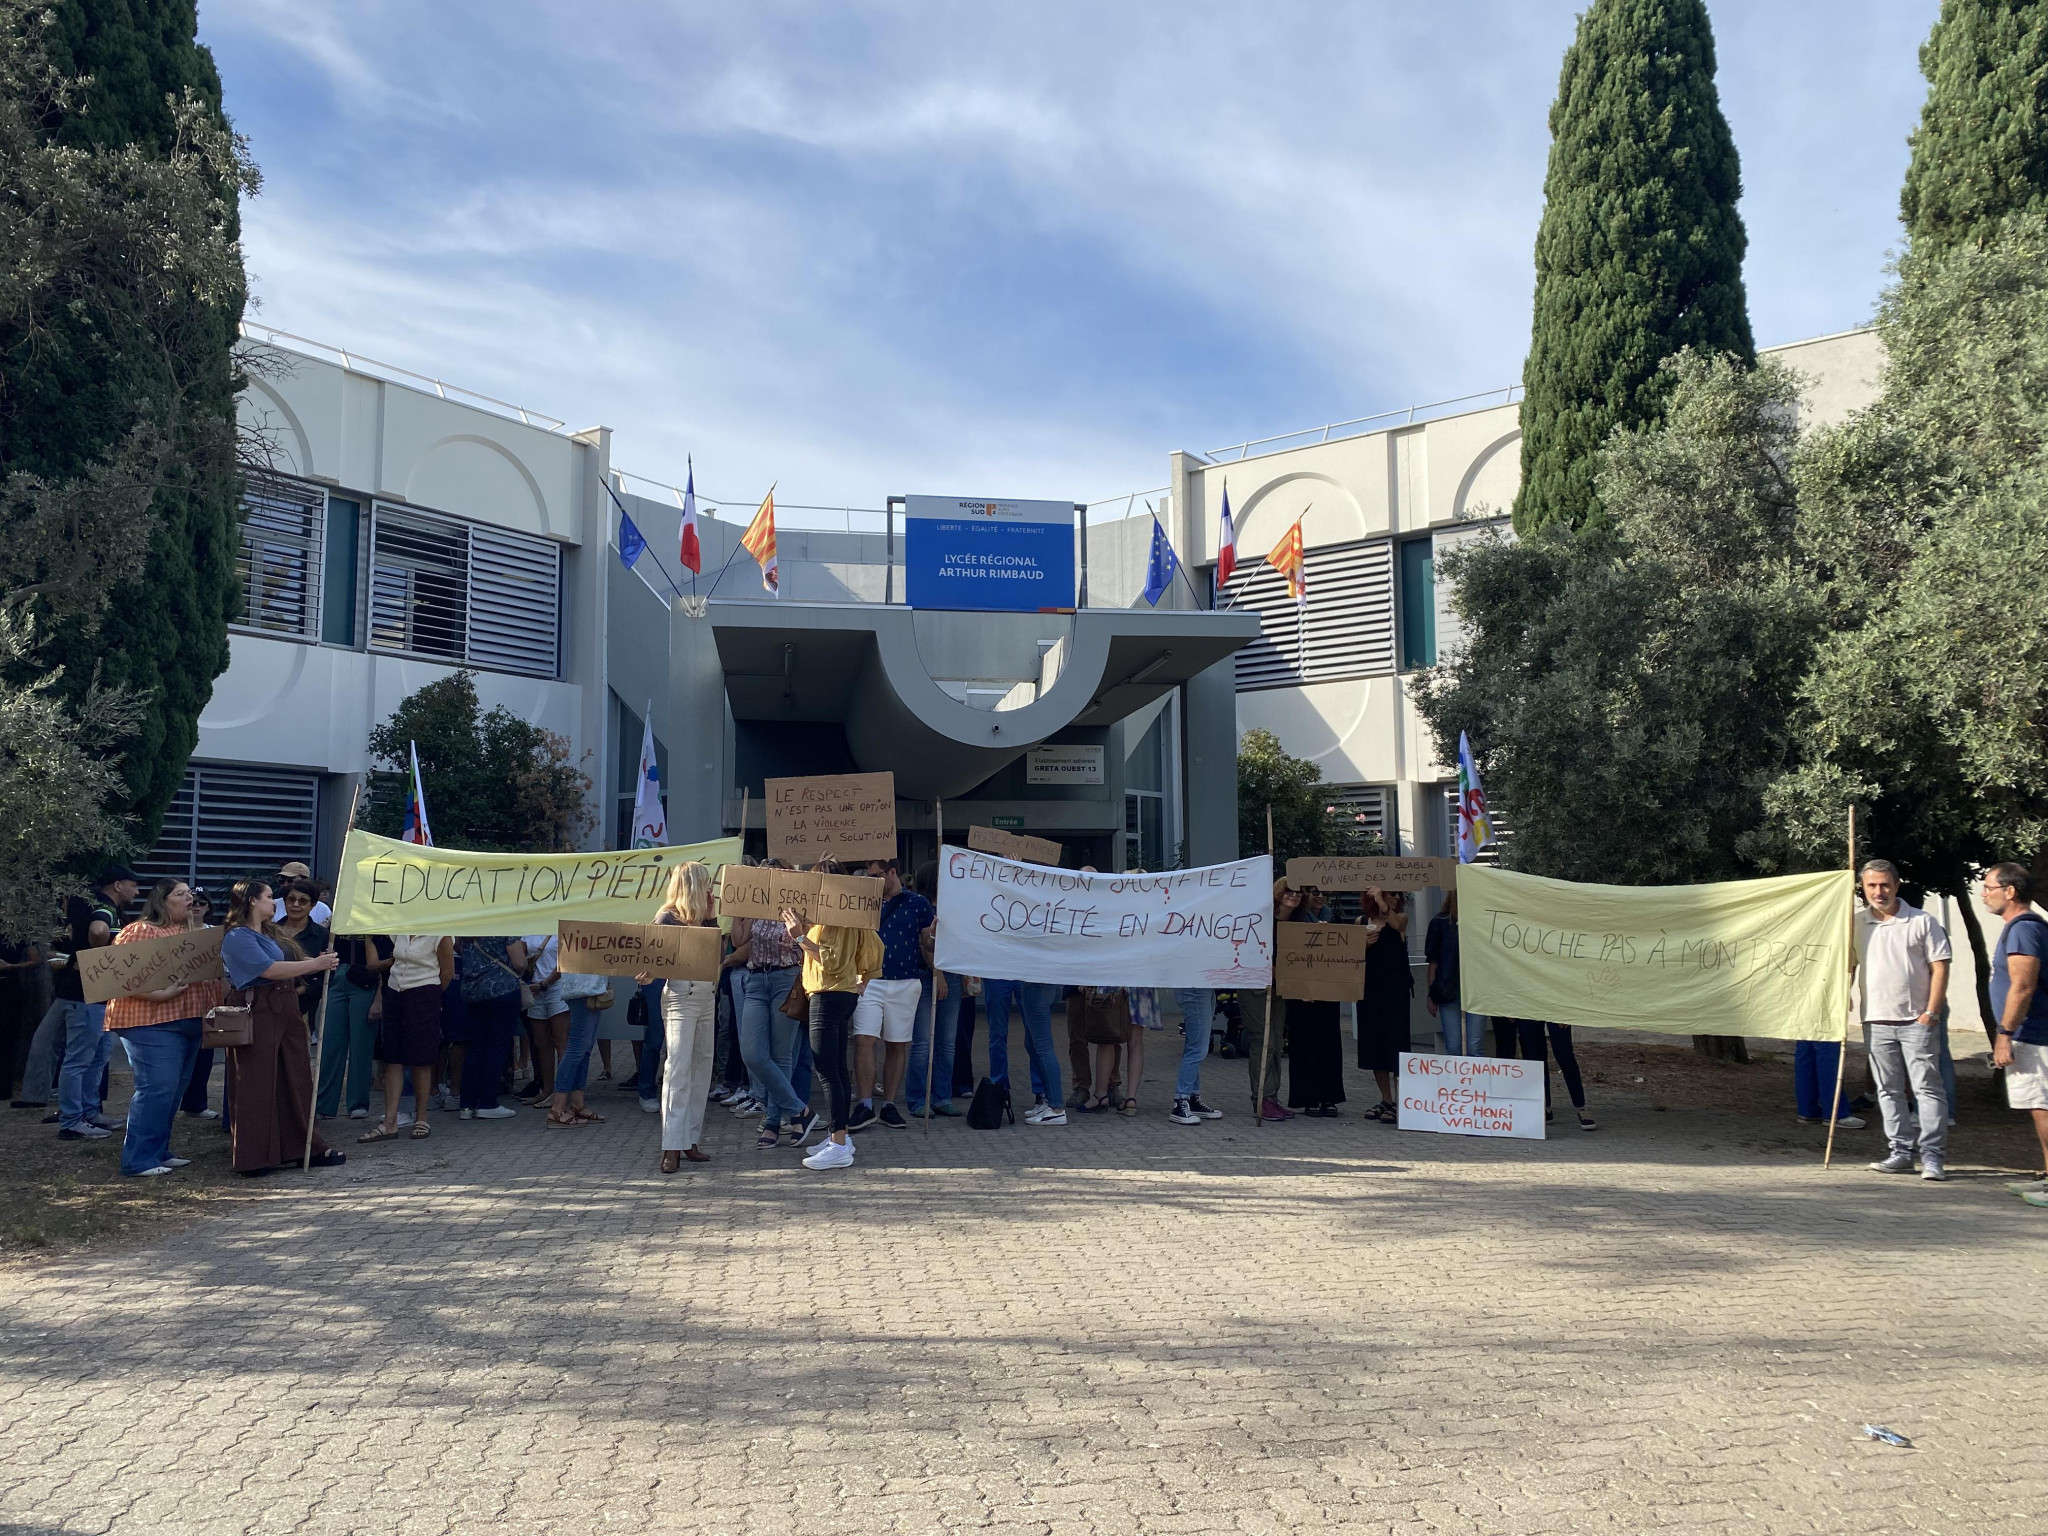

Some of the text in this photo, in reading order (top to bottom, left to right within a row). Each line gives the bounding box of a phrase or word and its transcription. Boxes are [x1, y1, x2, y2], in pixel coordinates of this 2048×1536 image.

[971, 525, 998, 533] ÉGALITÉ
[1007, 526, 1045, 534] FRATERNITÉ
[944, 553, 1038, 567] LYCÉE RÉGIONAL
[938, 567, 1044, 580] ARTHUR RIMBAUD
[776, 787, 863, 803] LE RESPECT
[774, 805, 809, 817] N'EST
[815, 805, 833, 813] PAS
[839, 802, 855, 812] UNE
[794, 820, 807, 830] LA
[785, 834, 807, 845] PAS
[817, 834, 831, 842] LA
[1312, 860, 1434, 872] MARRE DU BLABLA
[1321, 873, 1430, 886] ON VEUT DES ACTES
[723, 883, 771, 906] QU'EN
[1118, 913, 1149, 938] EN
[1157, 911, 1267, 946] DANGER
[647, 938, 665, 949] AU
[1485, 908, 1589, 960] TOUCHE
[1600, 933, 1637, 964] PAS
[1647, 928, 1666, 969] À
[1681, 938, 1738, 970] MON
[171, 939, 197, 961] PAS
[85, 950, 116, 983] FACE
[122, 951, 141, 968] LA
[1408, 1057, 1524, 1079] ENSEIGNANTS
[1460, 1077, 1473, 1086] ET
[1438, 1087, 1487, 1104] AESH
[1404, 1097, 1468, 1116] COLLEGE
[1442, 1117, 1513, 1132] WALLON
